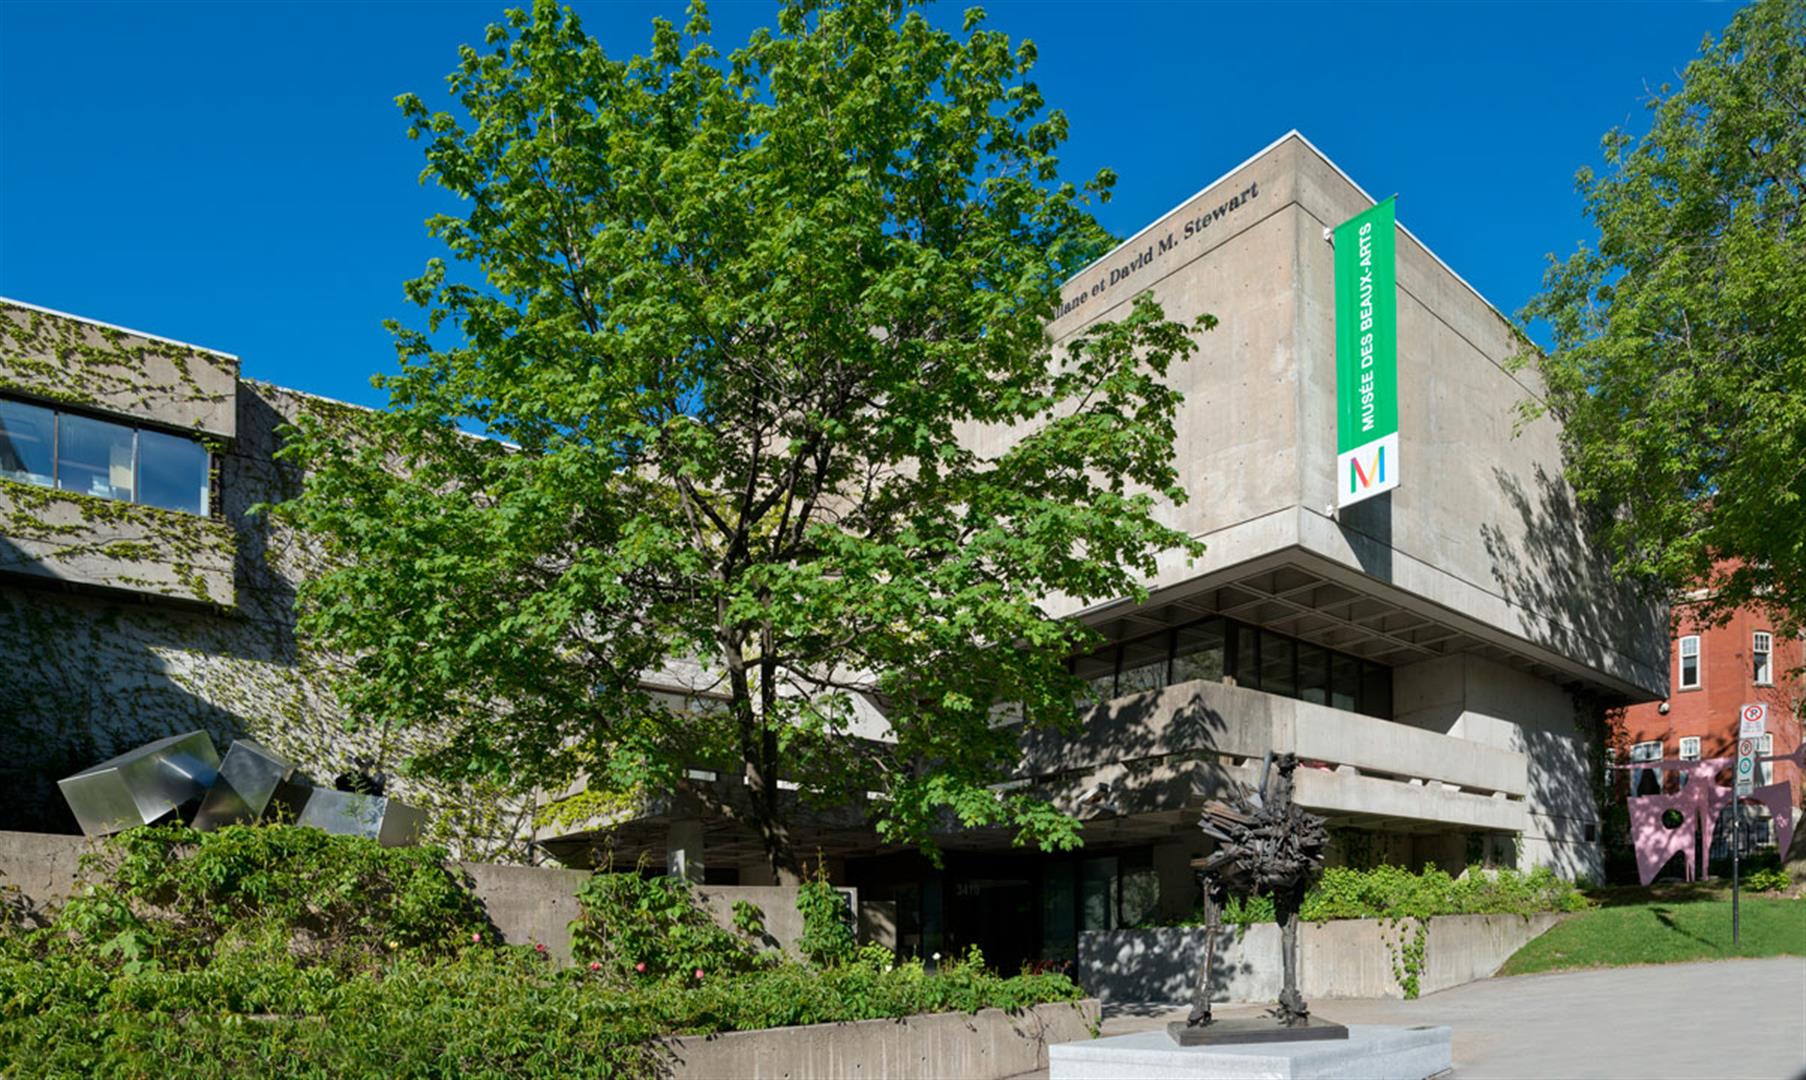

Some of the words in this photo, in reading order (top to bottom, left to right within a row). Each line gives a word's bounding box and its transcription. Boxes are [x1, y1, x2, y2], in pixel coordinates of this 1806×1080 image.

[1091, 278, 1105, 296] et
[1110, 246, 1154, 286] David
[1158, 233, 1178, 256] M.
[1184, 181, 1259, 240] Stewart
[1360, 222, 1373, 331] BEAUX-ARTS
[1361, 333, 1374, 368] DES
[1359, 370, 1375, 432] MUSÉE
[1350, 446, 1385, 494] M
